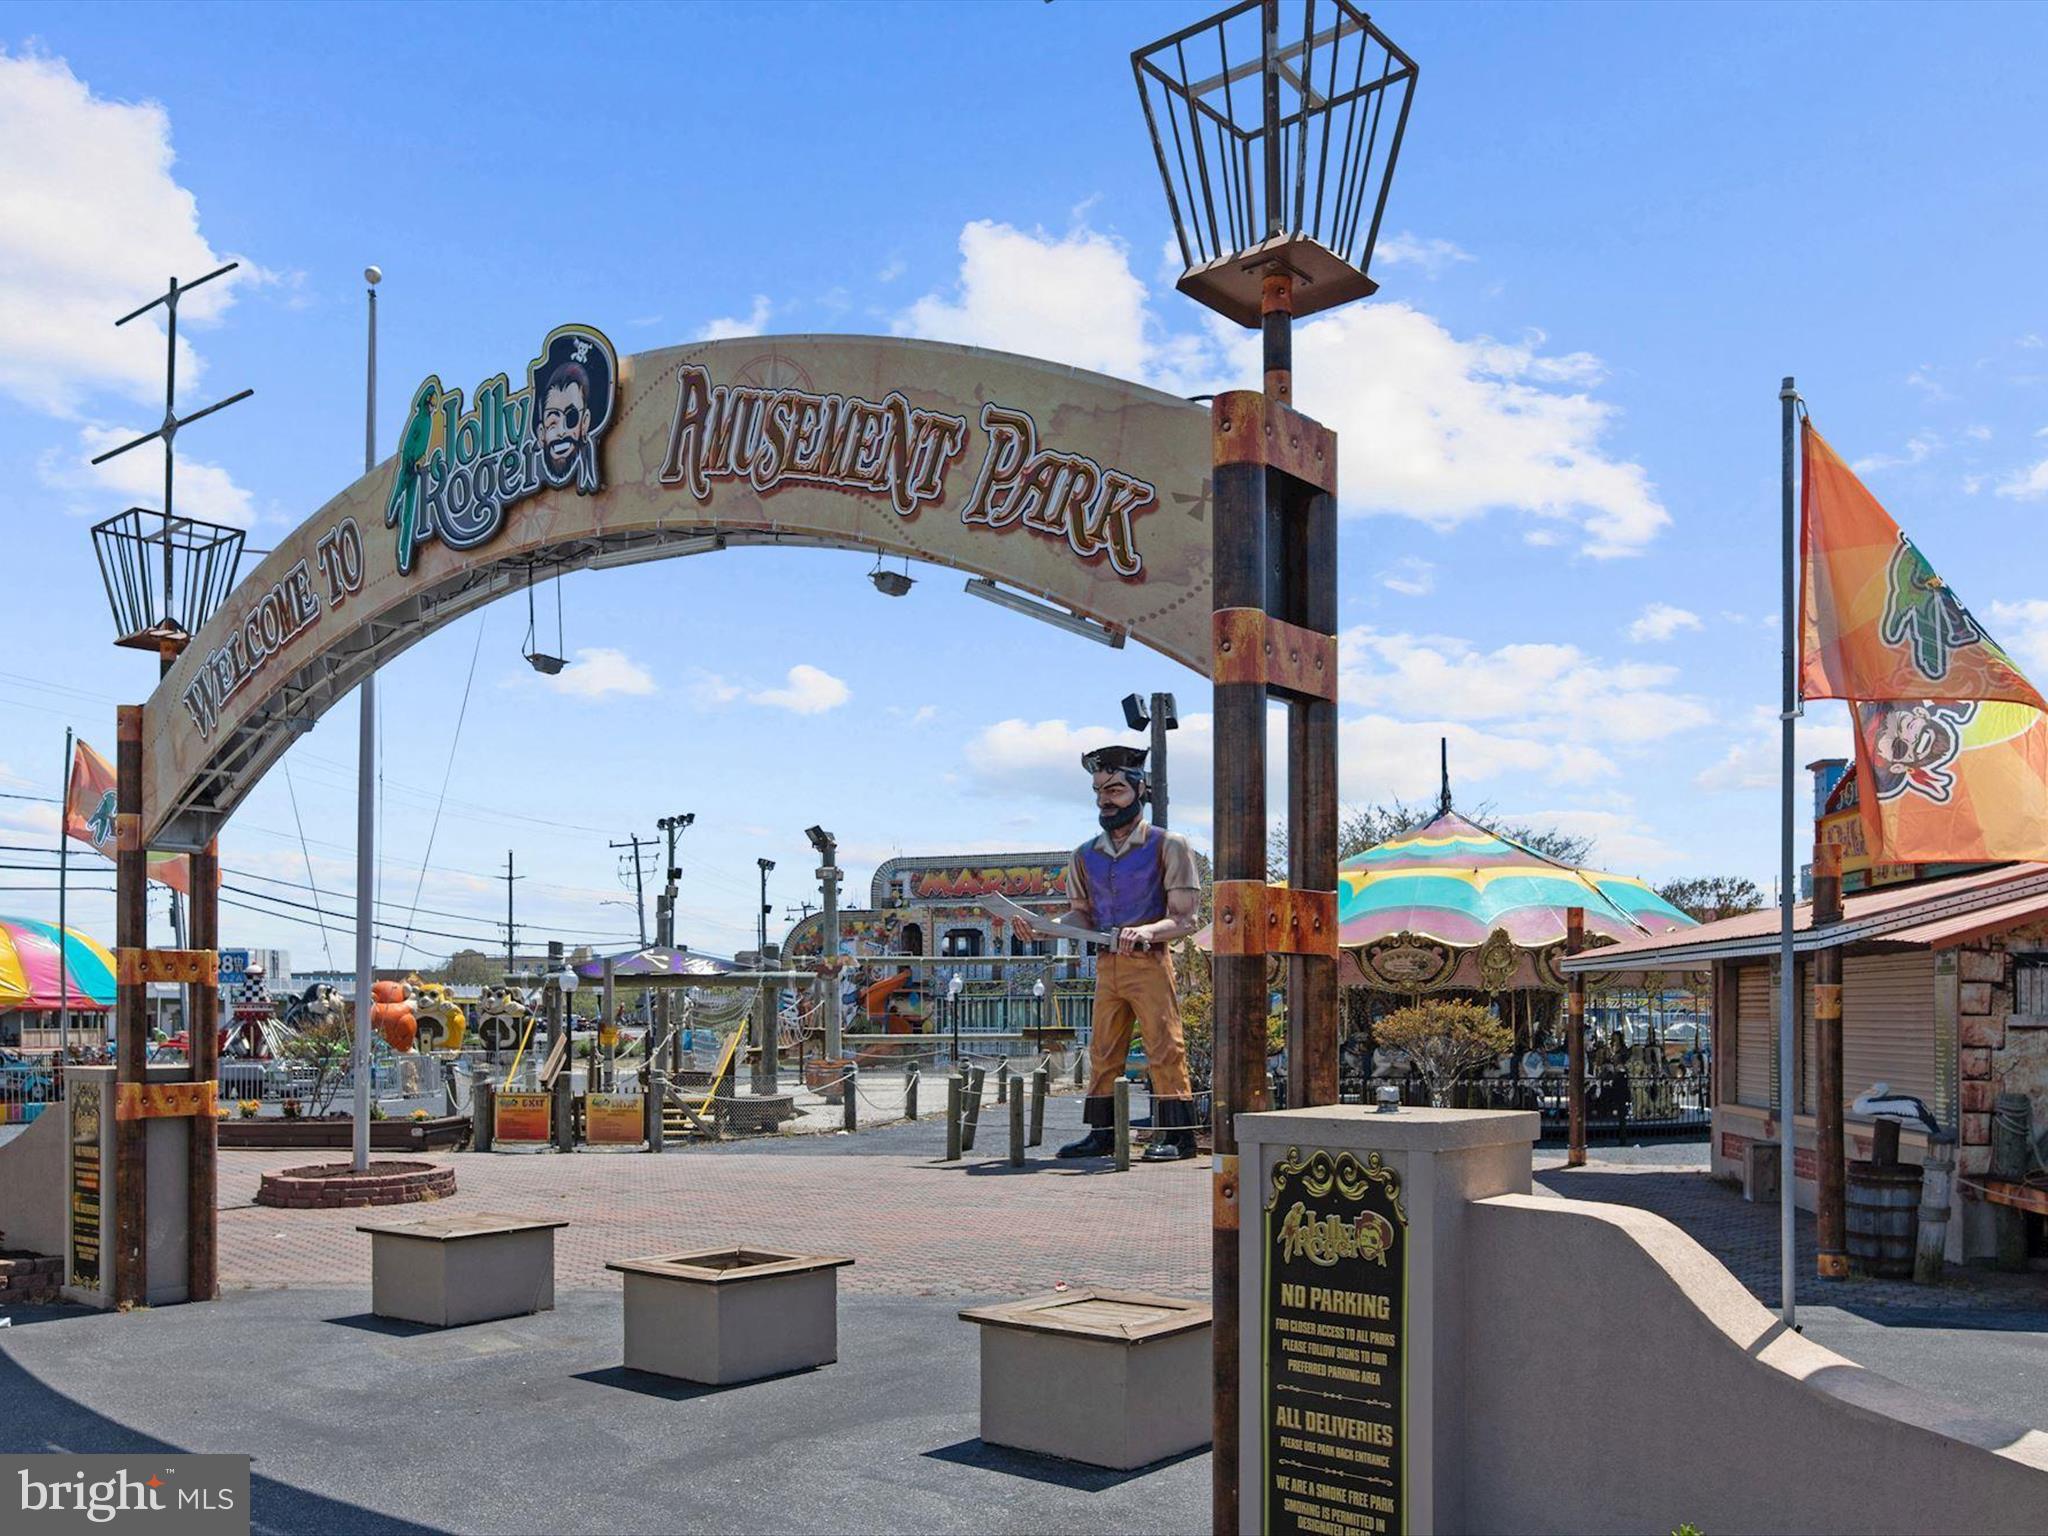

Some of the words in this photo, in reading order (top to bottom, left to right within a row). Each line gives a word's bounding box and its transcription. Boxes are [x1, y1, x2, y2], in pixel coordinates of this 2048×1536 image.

[430, 382, 530, 480] Jolly
[659, 364, 967, 515] AMUSEMENT
[961, 402, 1156, 577] PARK
[416, 440, 541, 545] Roger
[183, 558, 321, 738] WELCOME
[316, 516, 364, 606] TO
[218, 954, 244, 974] 8th
[1281, 1282, 1306, 1309] NO
[1310, 1287, 1390, 1320] PARKING
[1276, 1317, 1289, 1331] FOR
[1290, 1319, 1316, 1335] CLOSER
[1317, 1323, 1345, 1339] ACCESS
[1346, 1327, 1355, 1341] TO
[1356, 1329, 1369, 1343] ALL
[1370, 1331, 1395, 1347] PARKS
[1282, 1338, 1308, 1354] PLEASE
[1308, 1342, 1336, 1358] FOLLOW
[1336, 1346, 1360, 1362] SIGNS
[1361, 1350, 1370, 1364] TO
[1371, 1352, 1388, 1366] OUR
[1288, 1359, 1327, 1377] PREFERRED
[1328, 1366, 1360, 1382] PARKING
[1361, 1370, 1381, 1386] AREA
[1276, 1405, 1302, 1430] ALL
[1305, 1410, 1393, 1447] DELIVERIES
[1280, 1436, 1303, 1451] PLEASE
[1317, 1442, 1335, 1457] PARK
[1355, 1450, 1390, 1468] ENTRANCE
[1276, 1475, 1290, 1491] WE
[1291, 1478, 1308, 1495] ARE
[1308, 1481, 1315, 1497] A
[1316, 1483, 1347, 1503] SMOKE
[1348, 1488, 1369, 1508] FREE
[1370, 1494, 1394, 1514] PARK
[1284, 1498, 1320, 1517] SMOKING
[1321, 1506, 1331, 1520] IS
[1331, 1509, 1375, 1531] PERMITTED
[1375, 1517, 1386, 1533] IN
